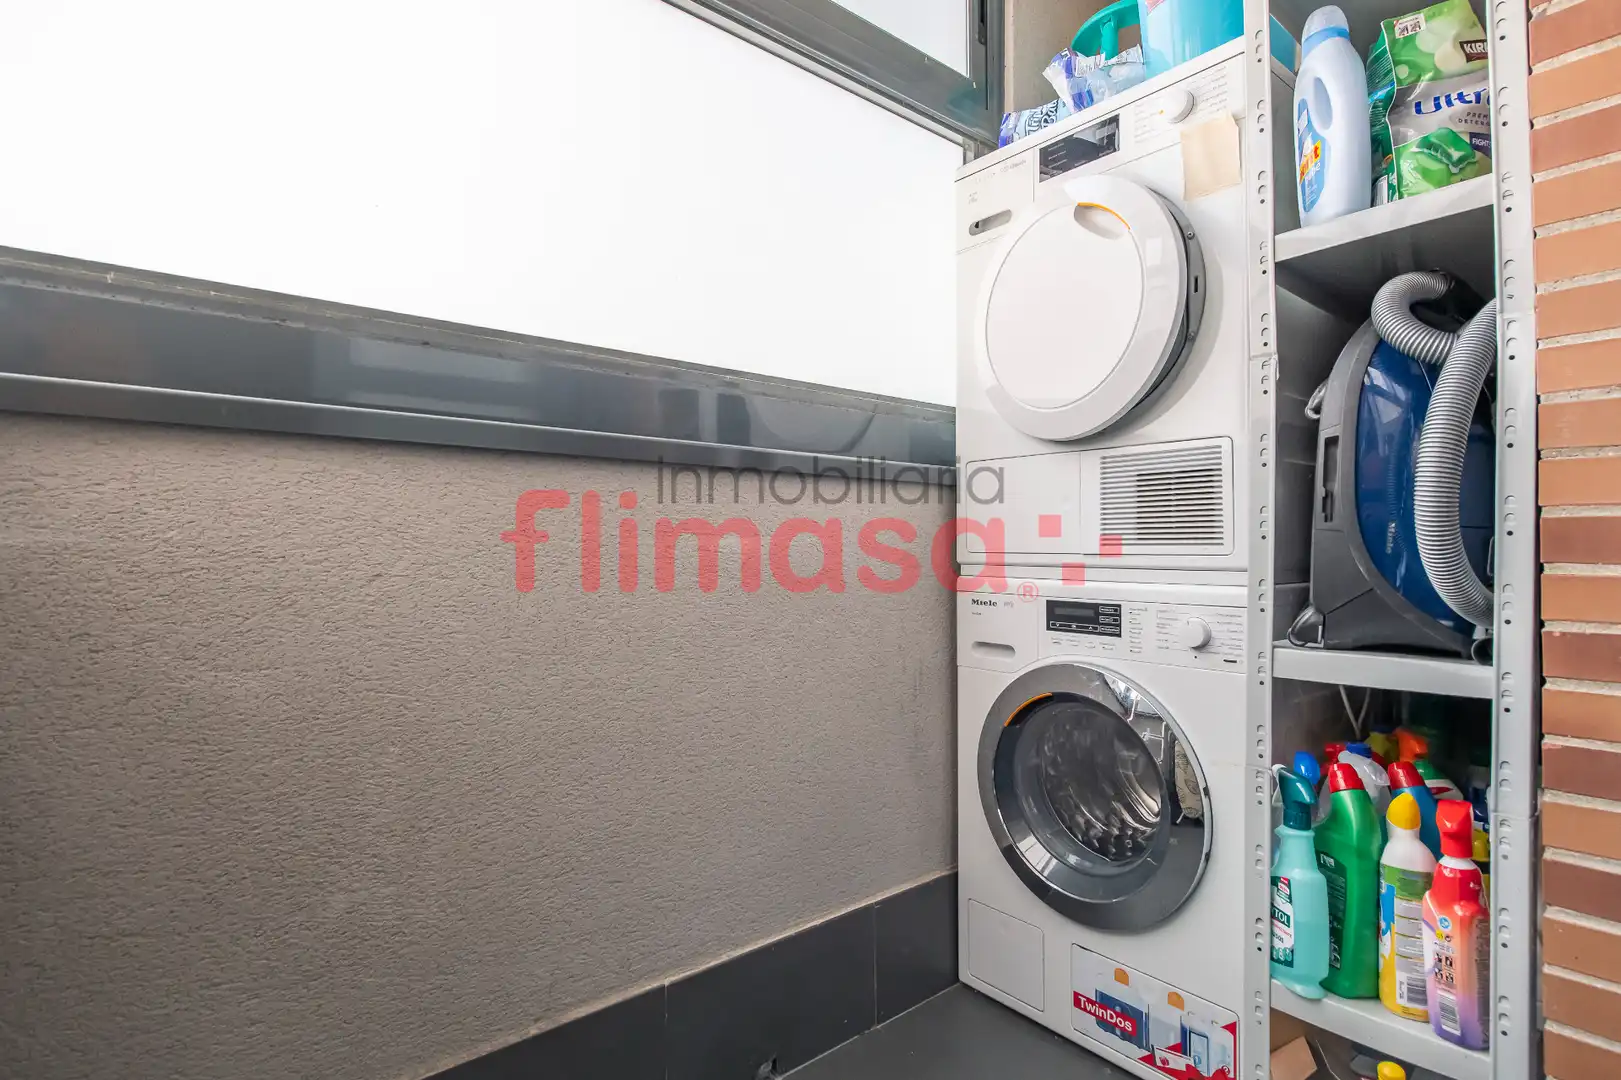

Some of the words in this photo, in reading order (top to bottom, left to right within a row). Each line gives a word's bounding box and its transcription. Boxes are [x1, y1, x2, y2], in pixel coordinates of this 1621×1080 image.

[1414, 86, 1490, 115] Ultr
[971, 598, 998, 608] Miele
[1077, 994, 1133, 1033] TwinDos
